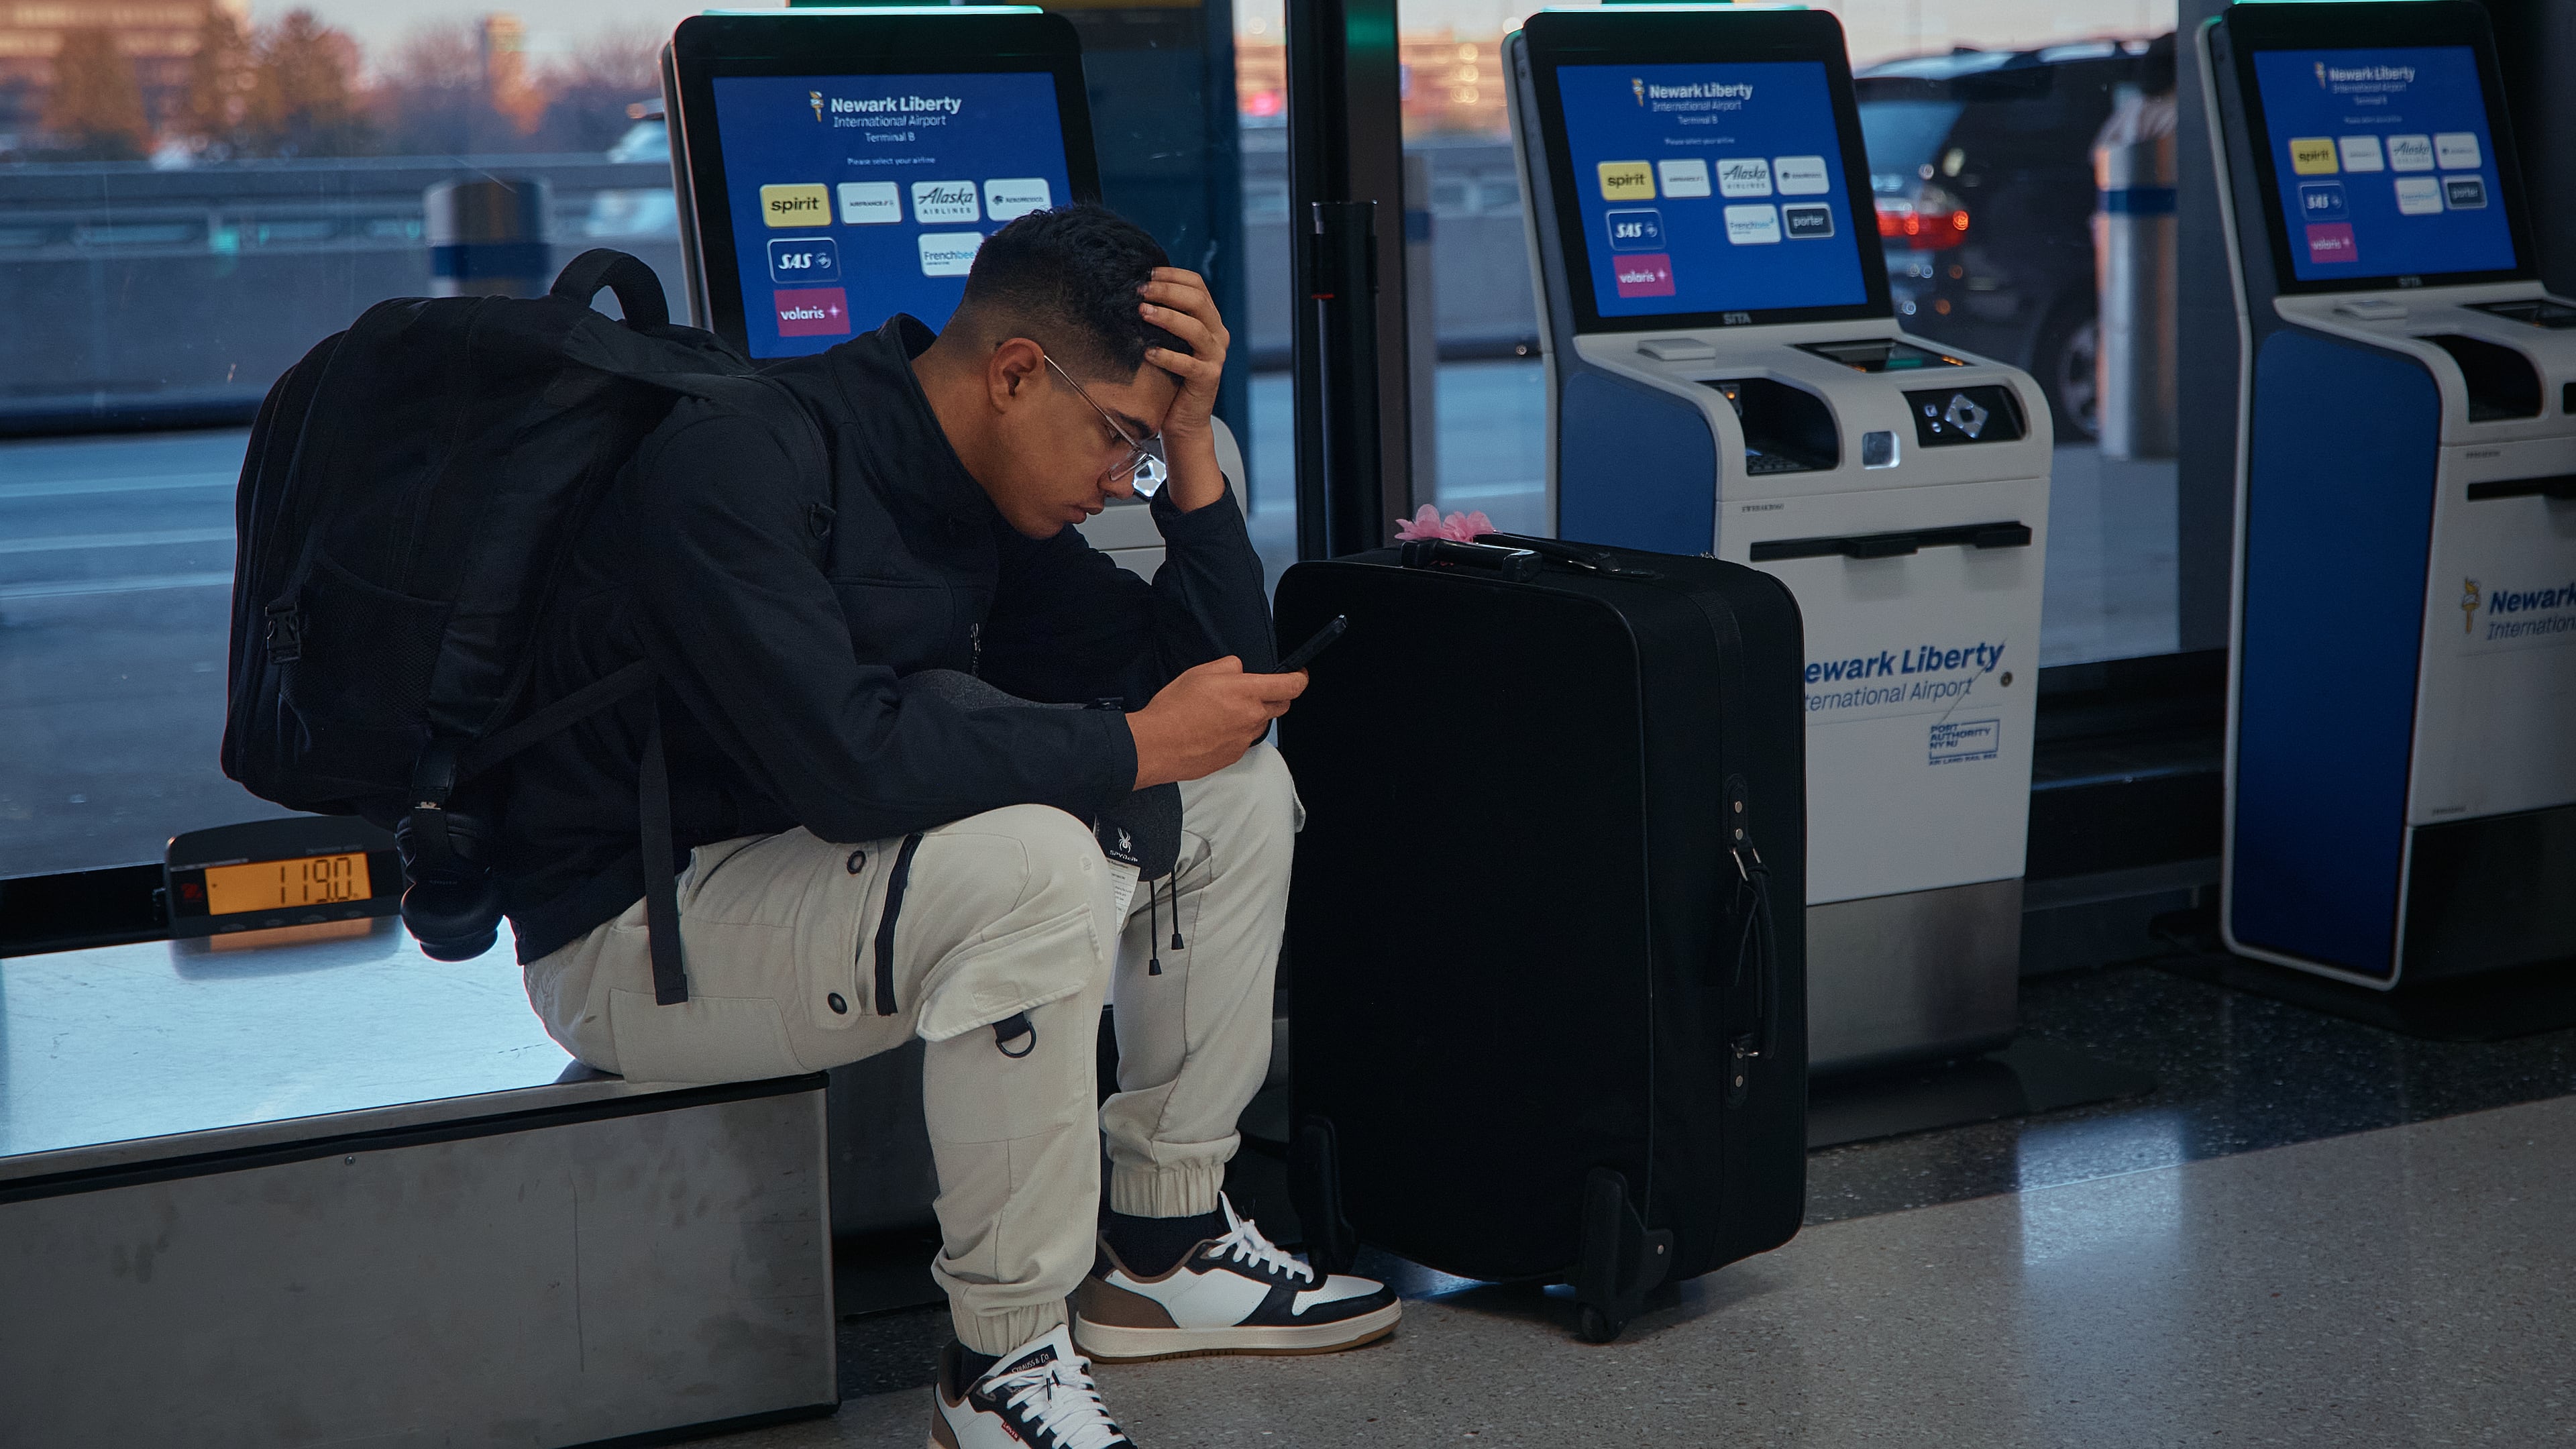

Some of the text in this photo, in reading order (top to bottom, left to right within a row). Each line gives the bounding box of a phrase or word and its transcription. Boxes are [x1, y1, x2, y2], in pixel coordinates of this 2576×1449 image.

[1649, 82, 1753, 100] Newark Liberty
[831, 95, 962, 114] Newark Liberty
[1652, 100, 1742, 112] International Airport
[833, 114, 947, 127] International Airport
[865, 131, 916, 142] Terminal B
[847, 157, 871, 166] Please
[1723, 165, 1768, 181] Alaska
[1607, 174, 1646, 189] spirit
[918, 186, 974, 205] Alaska
[771, 197, 820, 213] spirit
[922, 207, 972, 215] AIRLINES
[1792, 214, 1825, 229] porter
[1615, 222, 1643, 239] SAS
[778, 253, 812, 269] SAS
[1619, 268, 1656, 284] volaris
[780, 305, 825, 321] volaris
[1722, 312, 1752, 325] SITA
[2487, 614, 2576, 641] Internation
[1805, 641, 2006, 684] ewark Liberty
[1805, 677, 1973, 712] ternational Airport
[1931, 724, 1958, 733] PORT
[1931, 728, 1991, 741] AUTHORITY
[1930, 741, 1945, 749] NY
